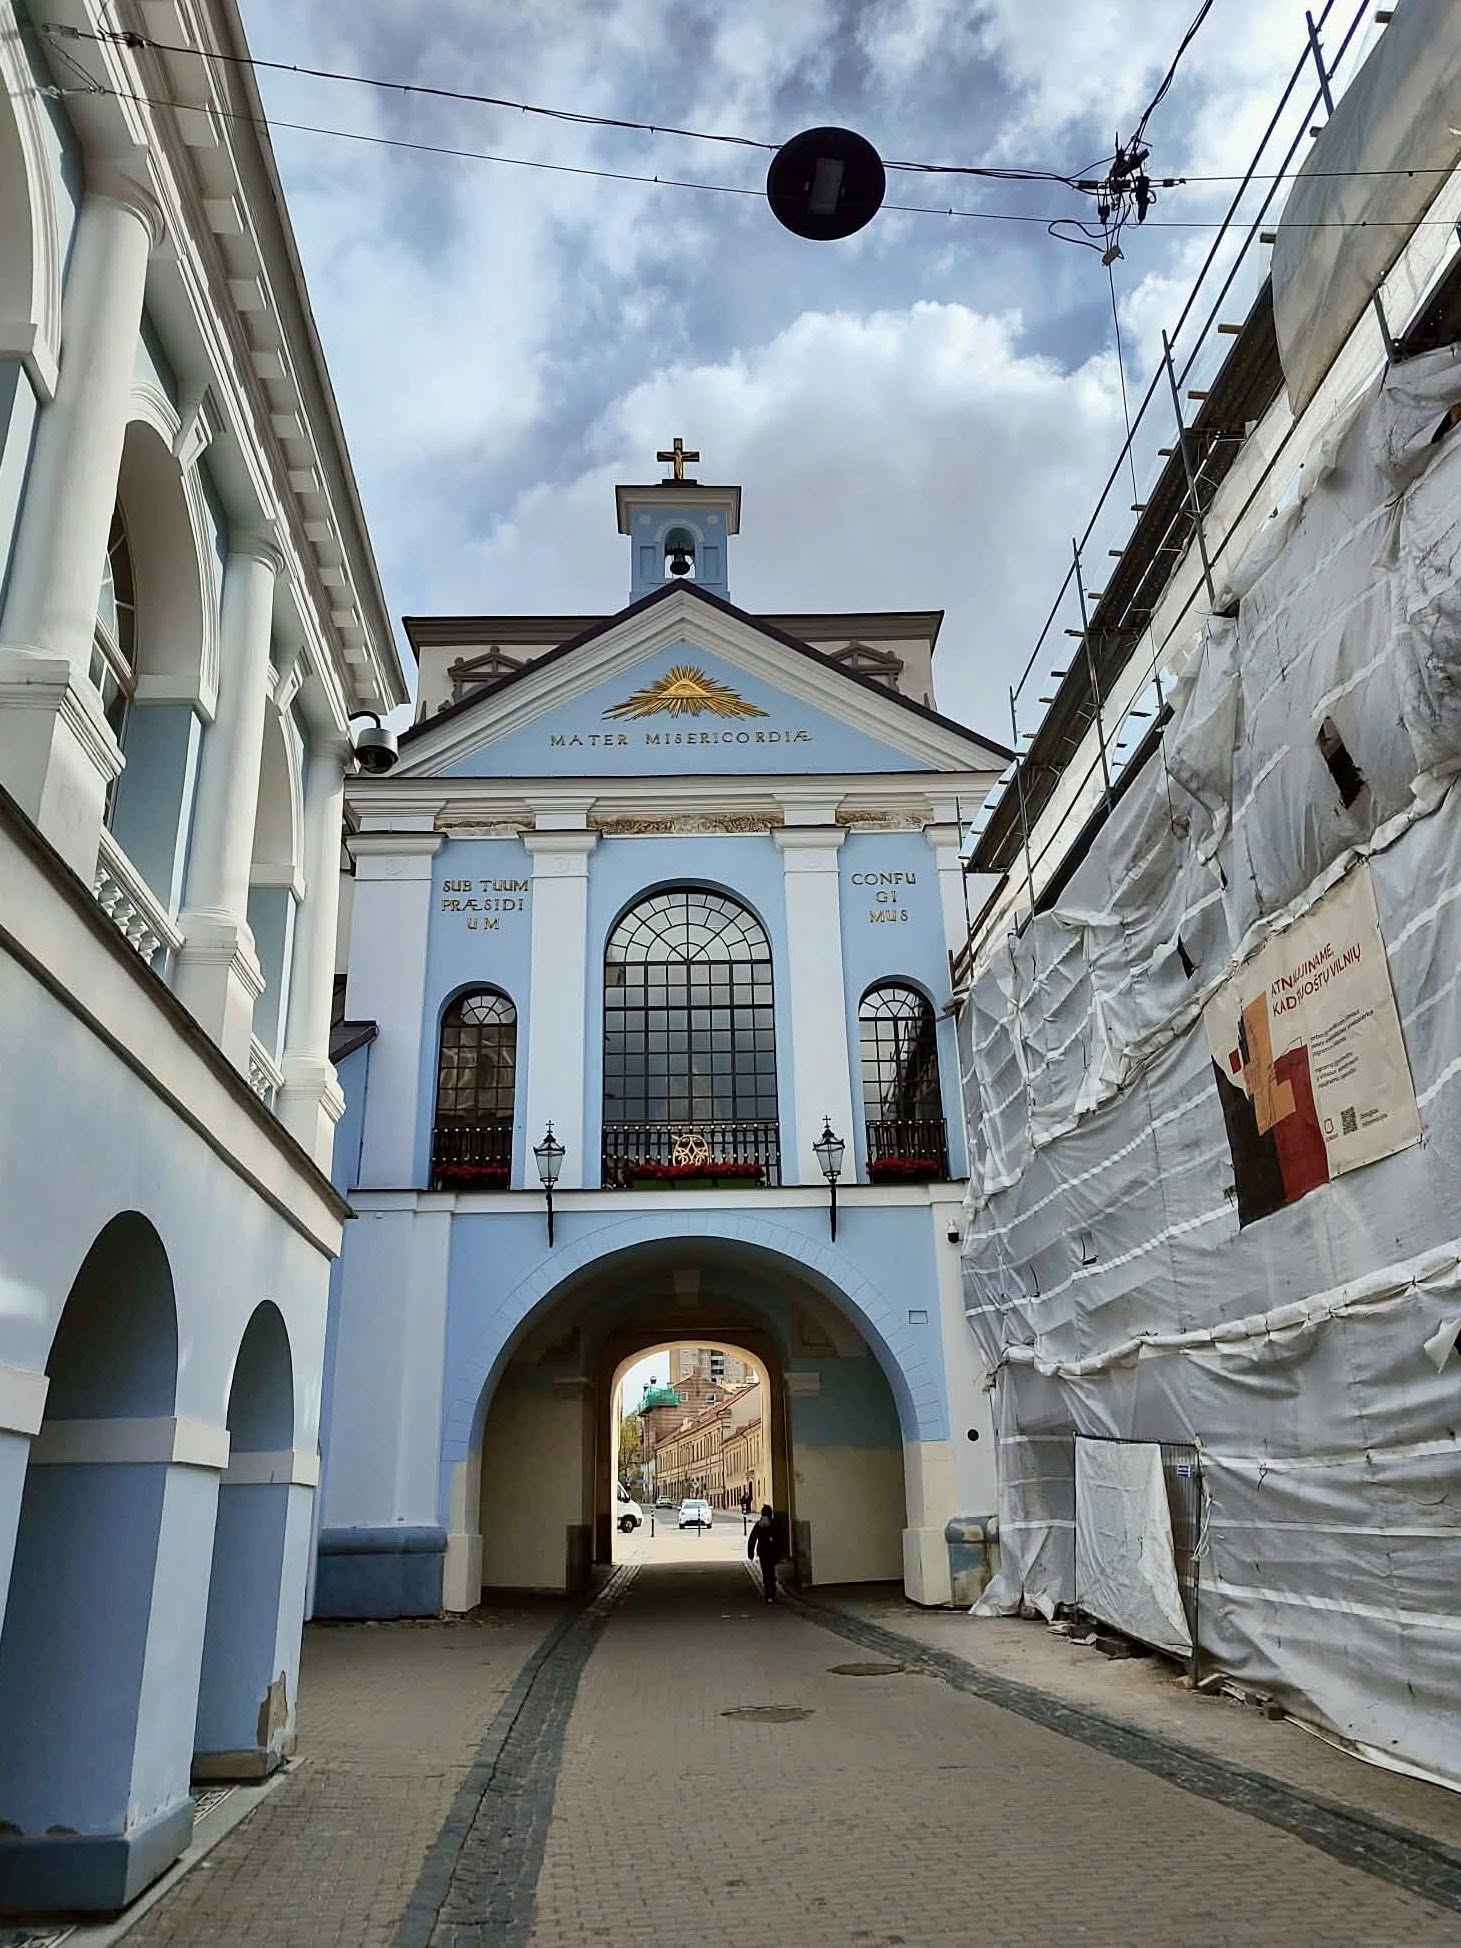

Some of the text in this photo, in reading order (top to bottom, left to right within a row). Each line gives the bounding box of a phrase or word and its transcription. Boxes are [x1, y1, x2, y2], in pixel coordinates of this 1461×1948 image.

[550, 730, 813, 747] MATER MISERICORDIÆ
[851, 873, 916, 885] CONFU
[442, 880, 528, 892] SUB TUUM
[875, 890, 897, 903] GI
[441, 899, 524, 911] PRÆSIDI
[869, 909, 908, 923] MUS
[467, 917, 500, 930] UM
[1329, 943, 1361, 977] VILNIŲ
